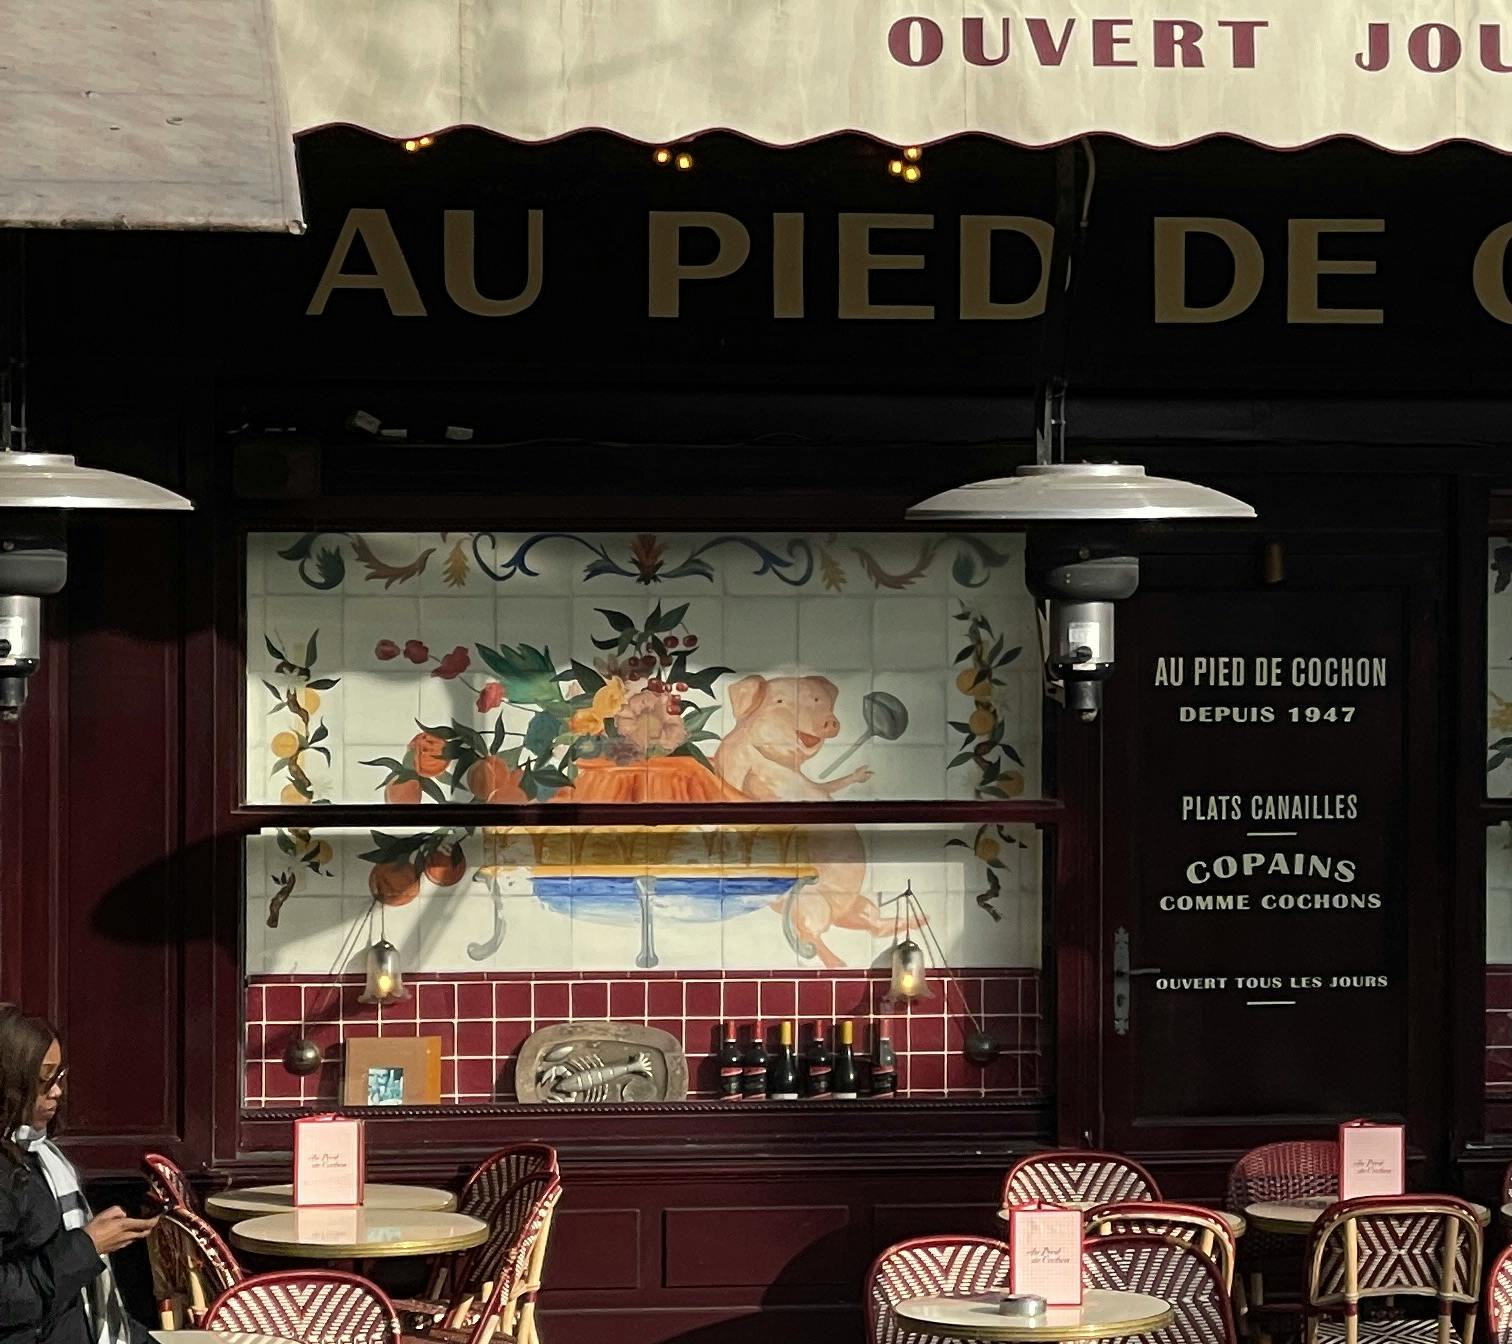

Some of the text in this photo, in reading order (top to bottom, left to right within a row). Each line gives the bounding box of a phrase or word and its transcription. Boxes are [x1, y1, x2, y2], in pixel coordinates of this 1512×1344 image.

[887, 15, 1269, 69] OUVERT
[304, 207, 545, 317] AU
[647, 209, 1056, 321] PIED
[1153, 215, 1385, 324] DE
[1154, 657, 1387, 687] AU PIED DE COCHON
[1179, 706, 1356, 723] DEPUIS 1947
[1182, 794, 1358, 820] PLATS CANAILLES
[1186, 852, 1356, 884] COPAINS
[1159, 893, 1382, 911] COMME COCHONS
[1155, 975, 1389, 990] OUVERT TOUS LES JOURS
